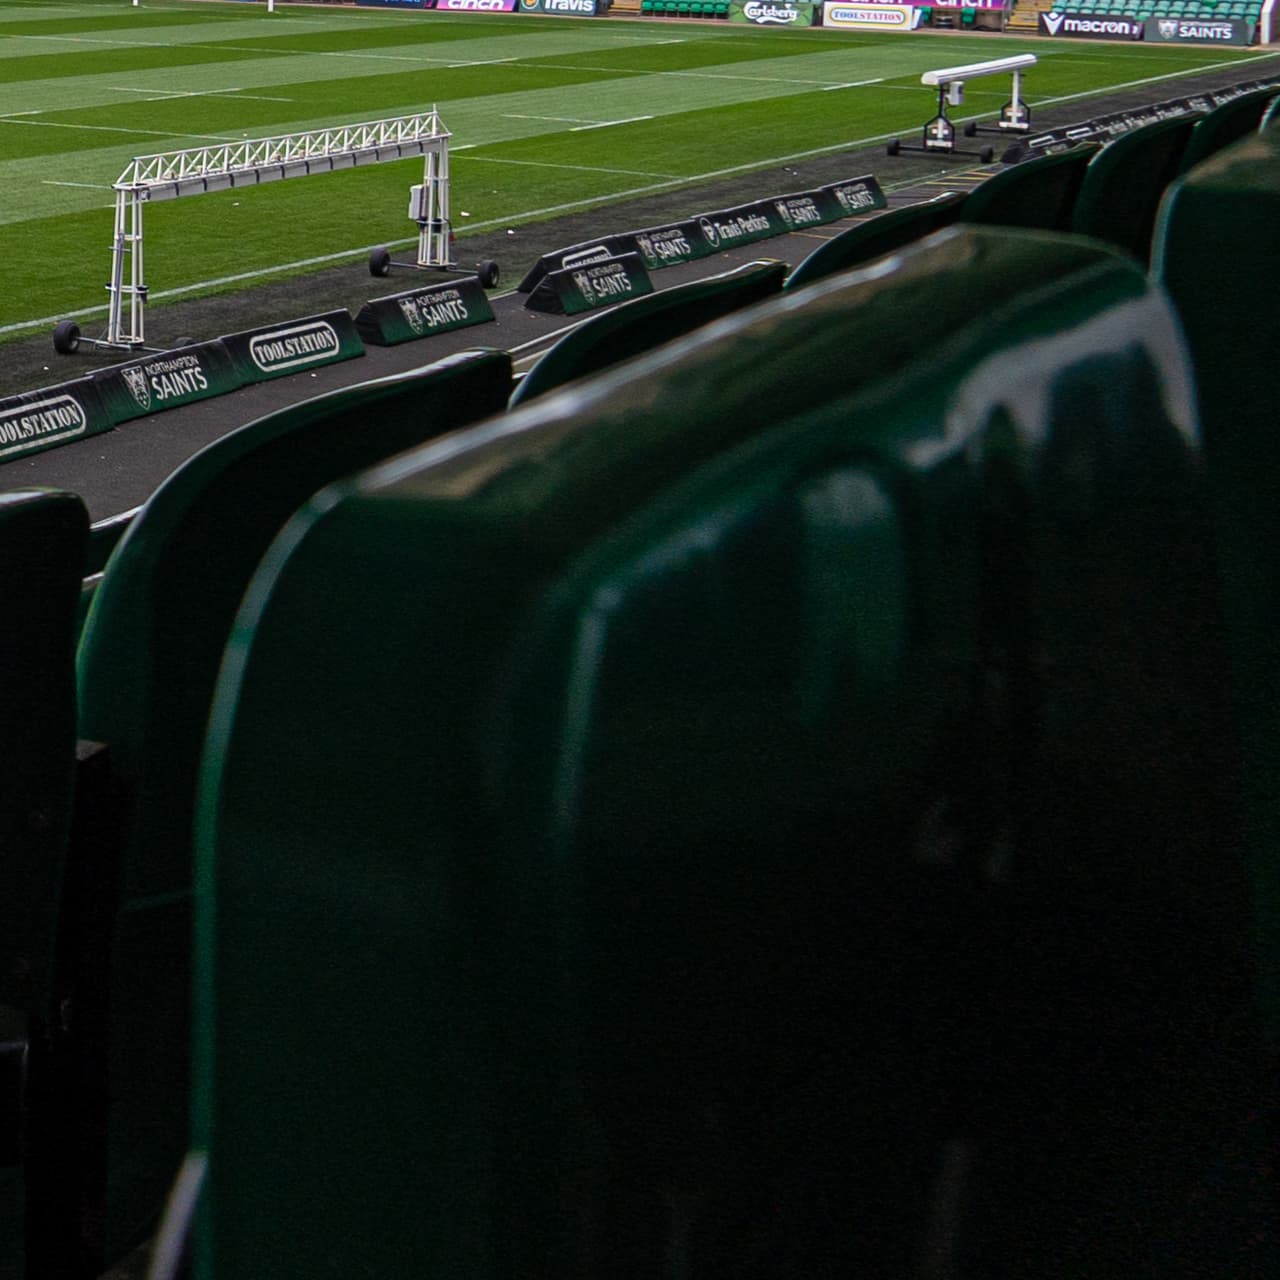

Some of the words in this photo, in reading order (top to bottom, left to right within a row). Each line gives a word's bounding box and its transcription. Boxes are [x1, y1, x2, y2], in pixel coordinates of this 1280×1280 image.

[743, 1, 798, 23] Carlsberg
[834, 11, 901, 21] TOOLSTATION
[1064, 19, 1129, 34] macron
[1179, 26, 1232, 39] SAINTS
[847, 190, 875, 208] SAINTS
[790, 205, 821, 223] SAINTS
[714, 219, 742, 239] Travis
[738, 214, 770, 234] Perkins
[654, 237, 691, 261] SAINTS
[592, 272, 632, 297] SAINTS
[416, 289, 460, 308] NORTHAMPTON
[421, 299, 468, 327] SAINTS
[255, 330, 336, 361] TOOLSTATION
[145, 354, 200, 377] NORTHAMPTON
[151, 367, 207, 401] SAINTS
